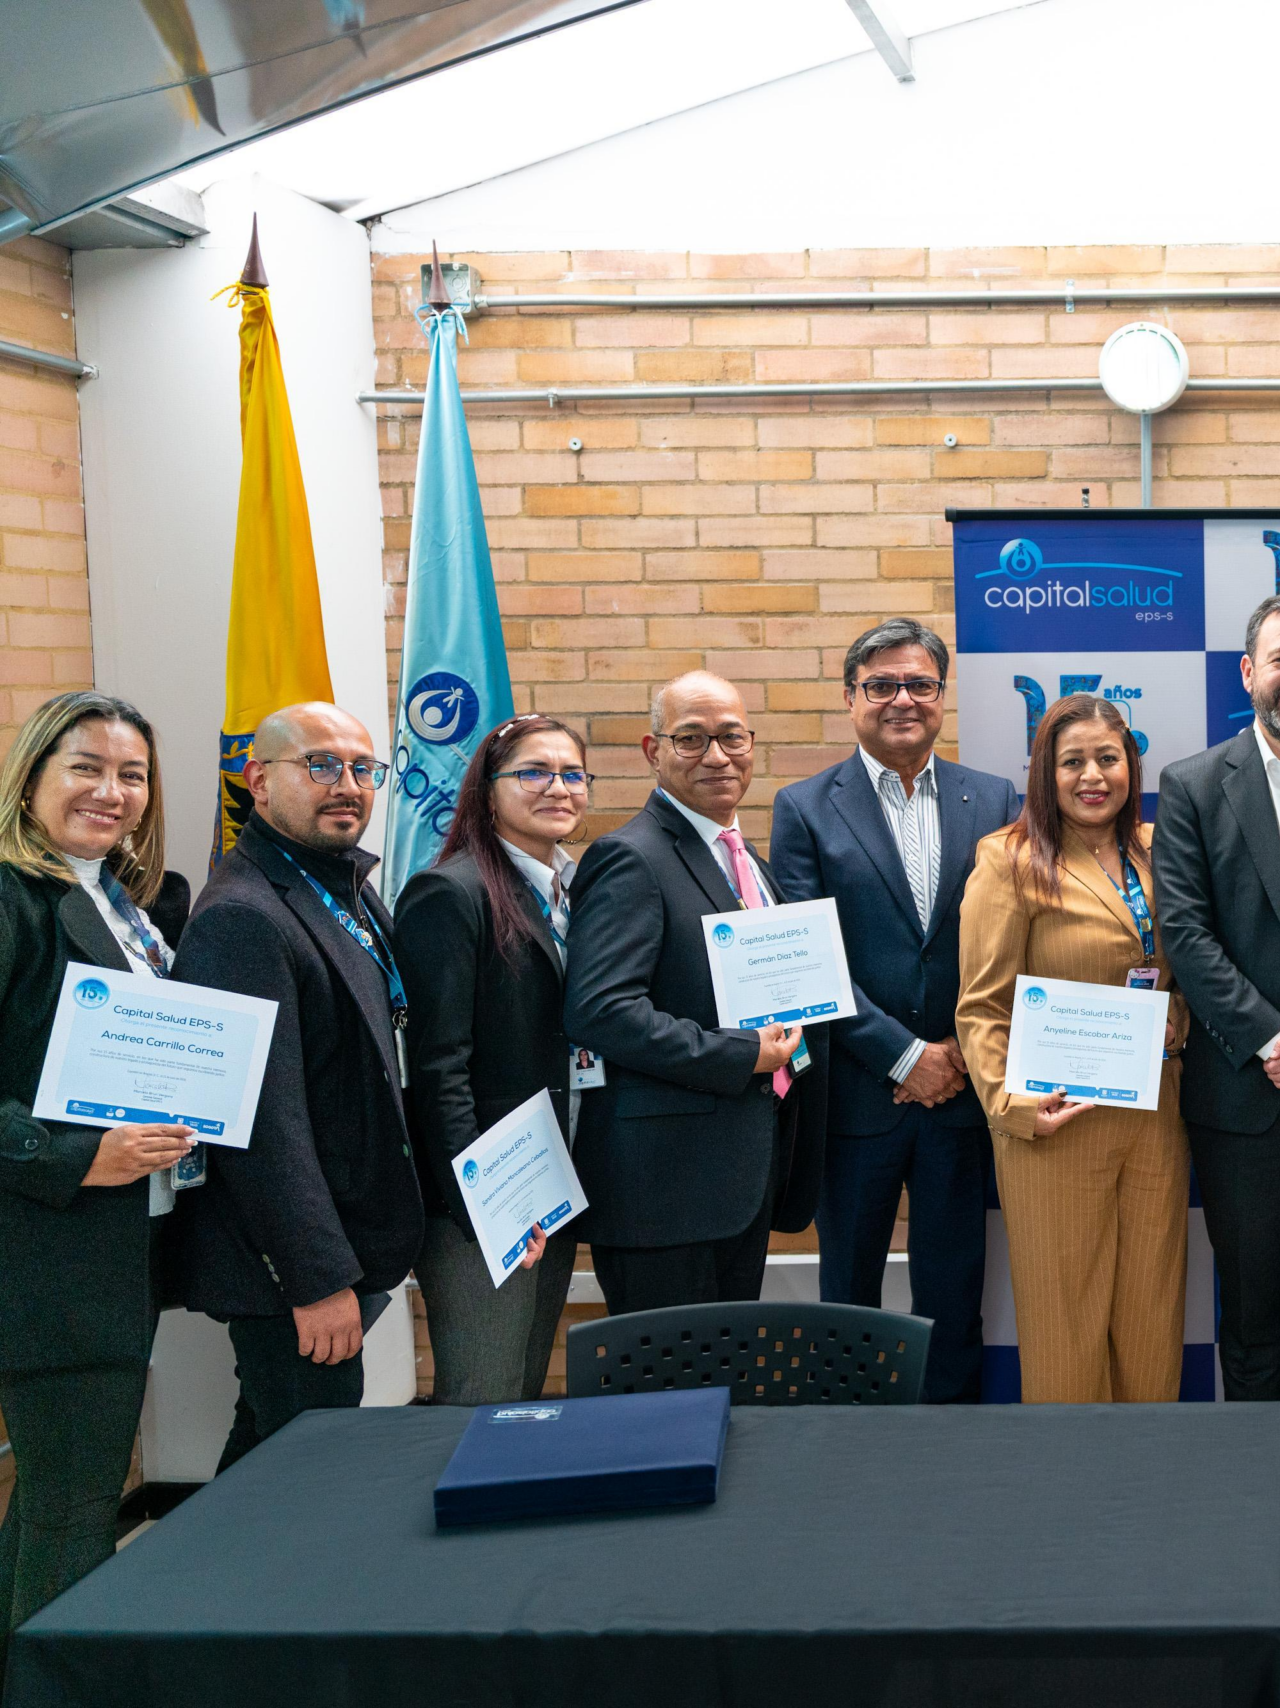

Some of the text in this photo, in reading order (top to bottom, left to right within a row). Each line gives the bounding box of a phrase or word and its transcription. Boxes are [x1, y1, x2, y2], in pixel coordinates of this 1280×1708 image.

[984, 580, 1173, 614] capitalsalud
[1135, 611, 1173, 622] eps-s
[1104, 685, 1142, 699] años
[740, 935, 765, 946] Capital
[765, 931, 786, 942] Salud
[787, 927, 809, 938] EPS-S
[748, 954, 776, 966] Germán
[793, 949, 808, 959] Tello
[81, 985, 98, 1000] 15
[113, 1005, 224, 1032] Capital Salud EPS-S
[1050, 1005, 1130, 1020] Capital Salud EPS-S
[1043, 1025, 1133, 1041] Anyeline Escobar Ariza
[101, 1030, 224, 1058] Andrea Carrillo Correa
[483, 1131, 533, 1177] Capital Salud EPS-S
